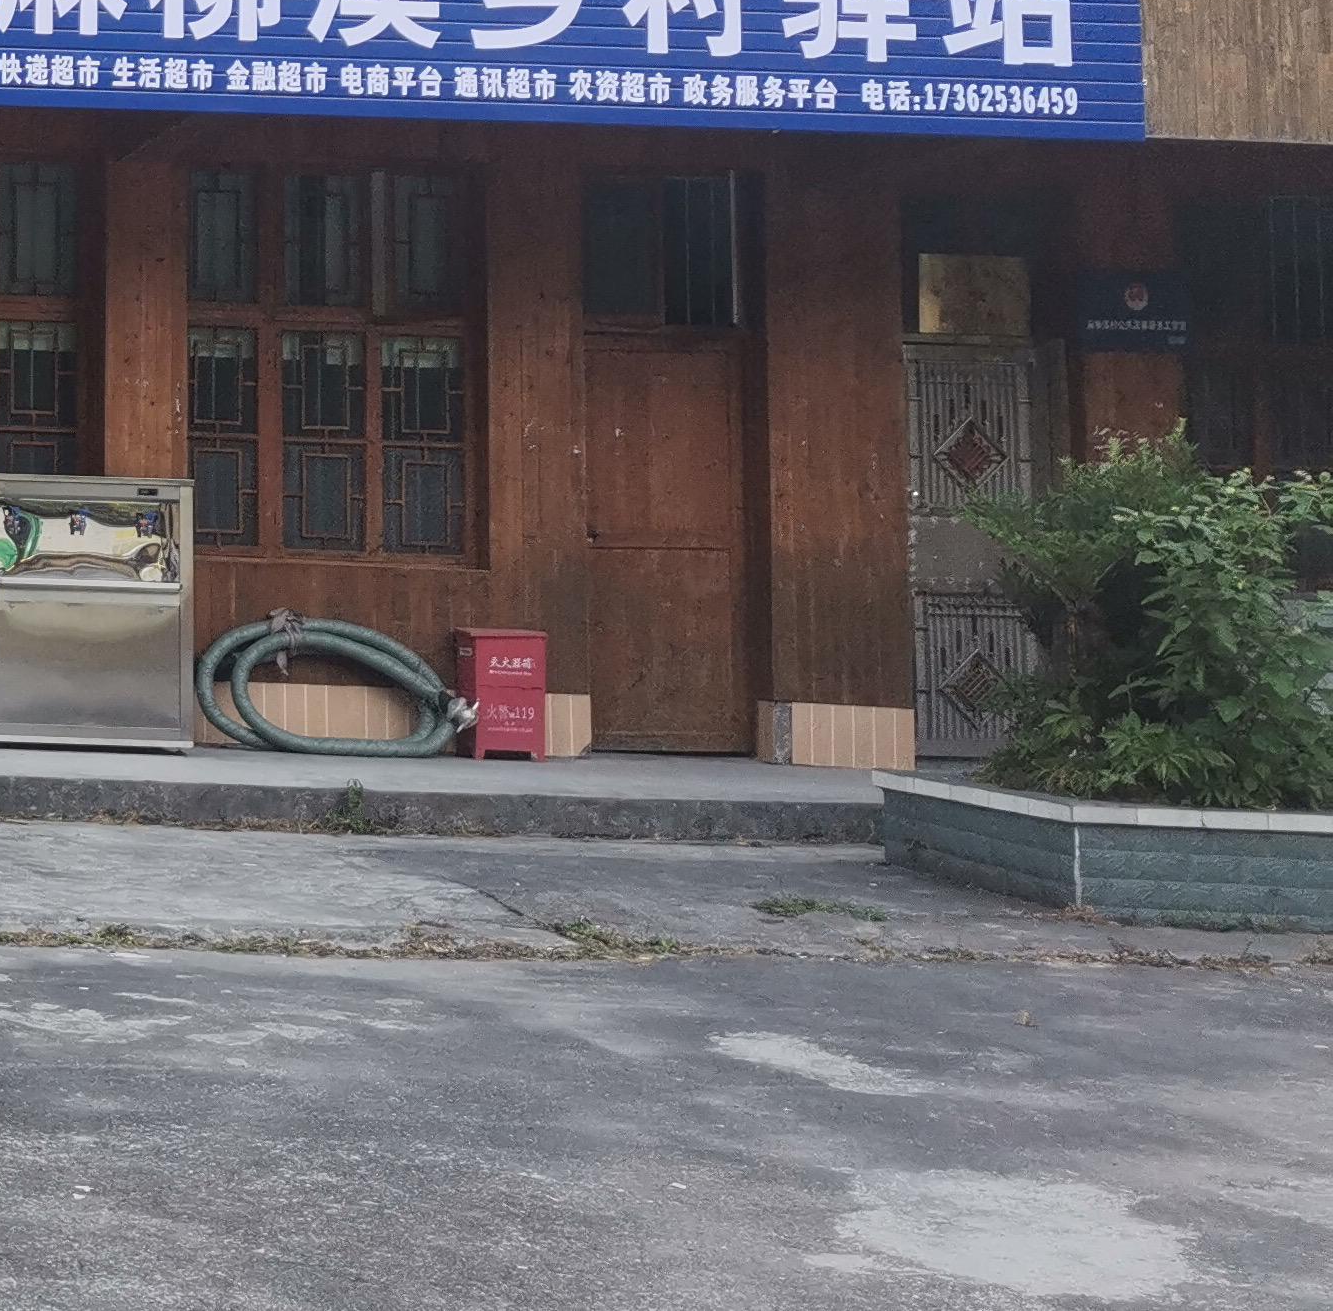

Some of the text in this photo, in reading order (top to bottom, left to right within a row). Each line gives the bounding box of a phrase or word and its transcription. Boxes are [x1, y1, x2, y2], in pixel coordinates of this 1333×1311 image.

[112, 56, 214, 90] 生活超市
[226, 59, 328, 93] 金融超市
[340, 63, 441, 97] 电商平台
[454, 67, 556, 100] 通讯超市
[568, 69, 671, 104] 农资超市
[683, 73, 838, 109] 政务服务平台
